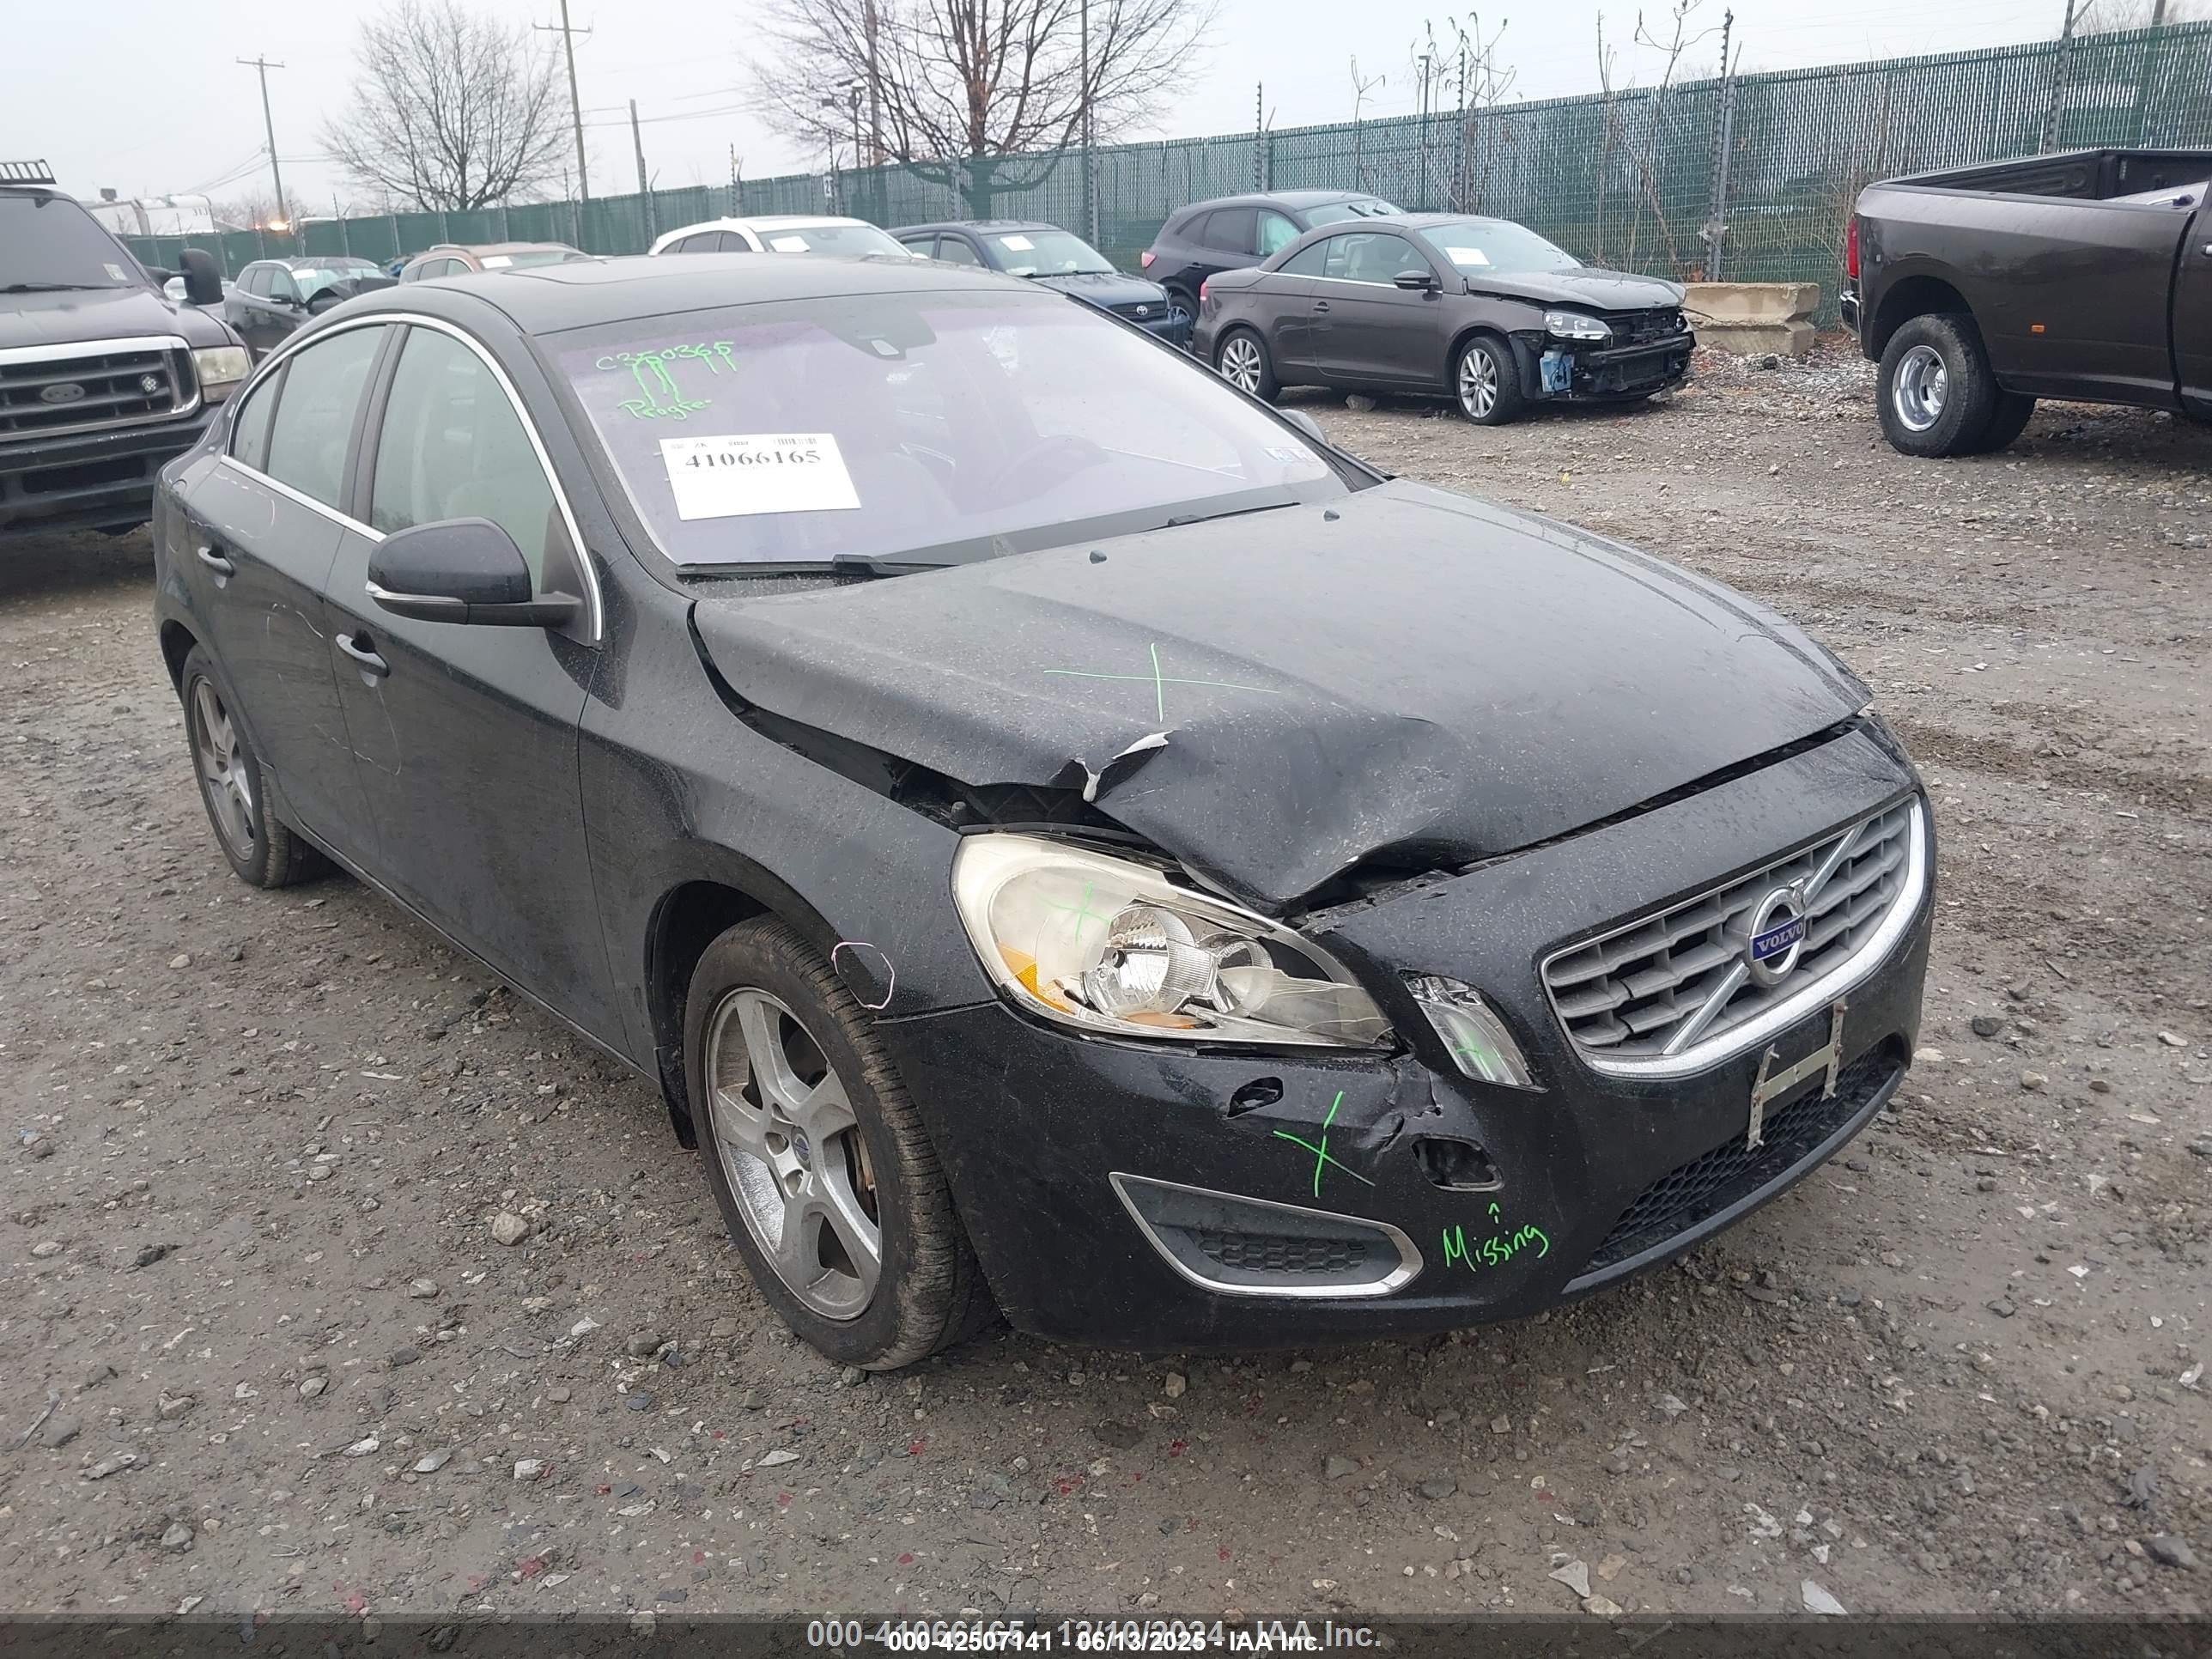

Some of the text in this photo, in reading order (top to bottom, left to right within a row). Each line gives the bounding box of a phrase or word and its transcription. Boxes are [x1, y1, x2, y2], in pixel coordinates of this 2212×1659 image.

[685, 449, 821, 468] 41066165
[1756, 921, 1803, 952] VOLVO
[1443, 1224, 1549, 1273] Missing
